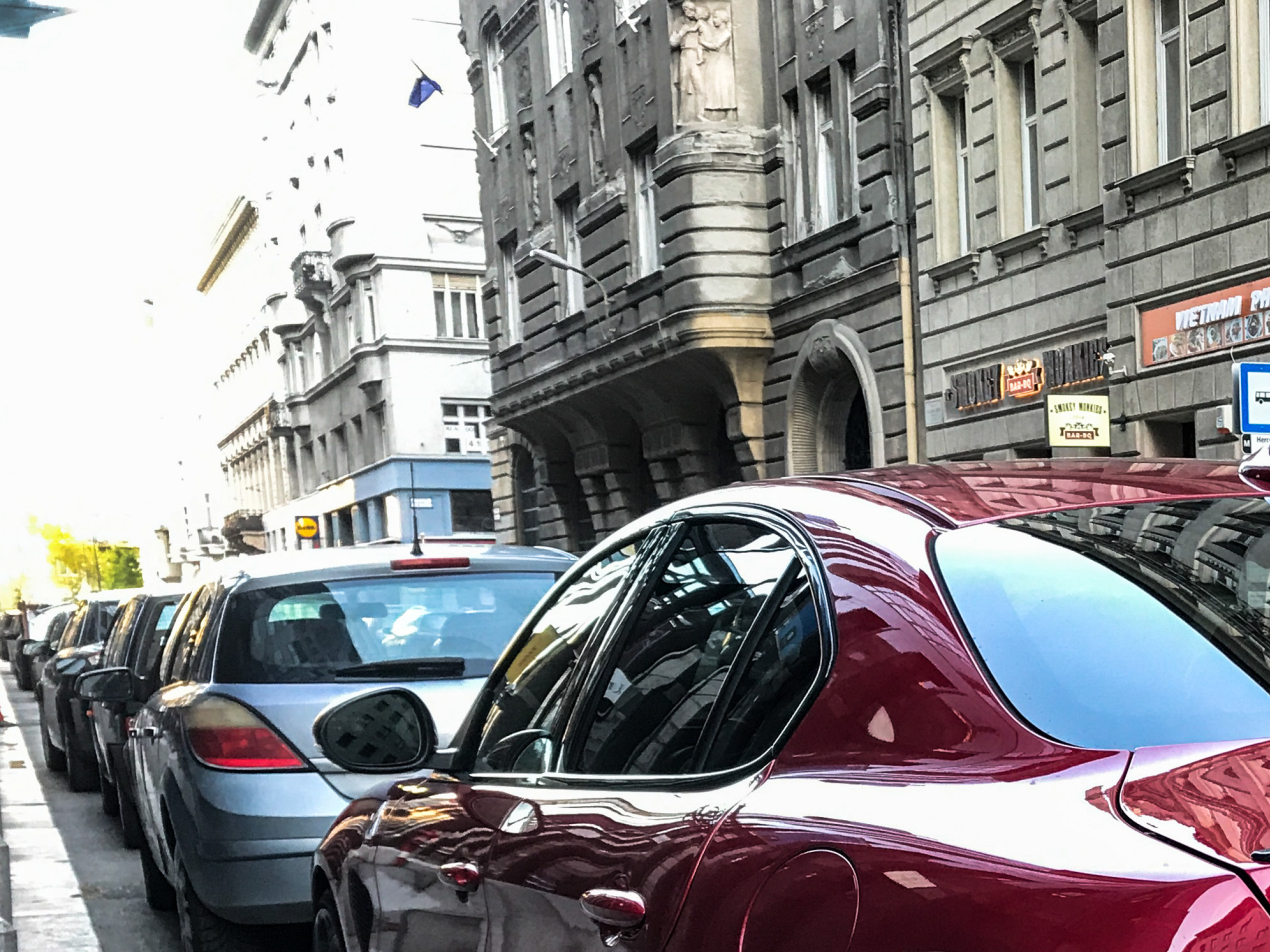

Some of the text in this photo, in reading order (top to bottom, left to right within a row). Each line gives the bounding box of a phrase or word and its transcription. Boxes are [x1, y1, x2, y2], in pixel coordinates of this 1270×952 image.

[1175, 295, 1243, 331] VIETNAM
[1009, 378, 1032, 392] BAR-BQ
[1054, 402, 1076, 414] SMOKEY
[1066, 432, 1093, 440] BAR-BQ
[1243, 439, 1251, 447] M
